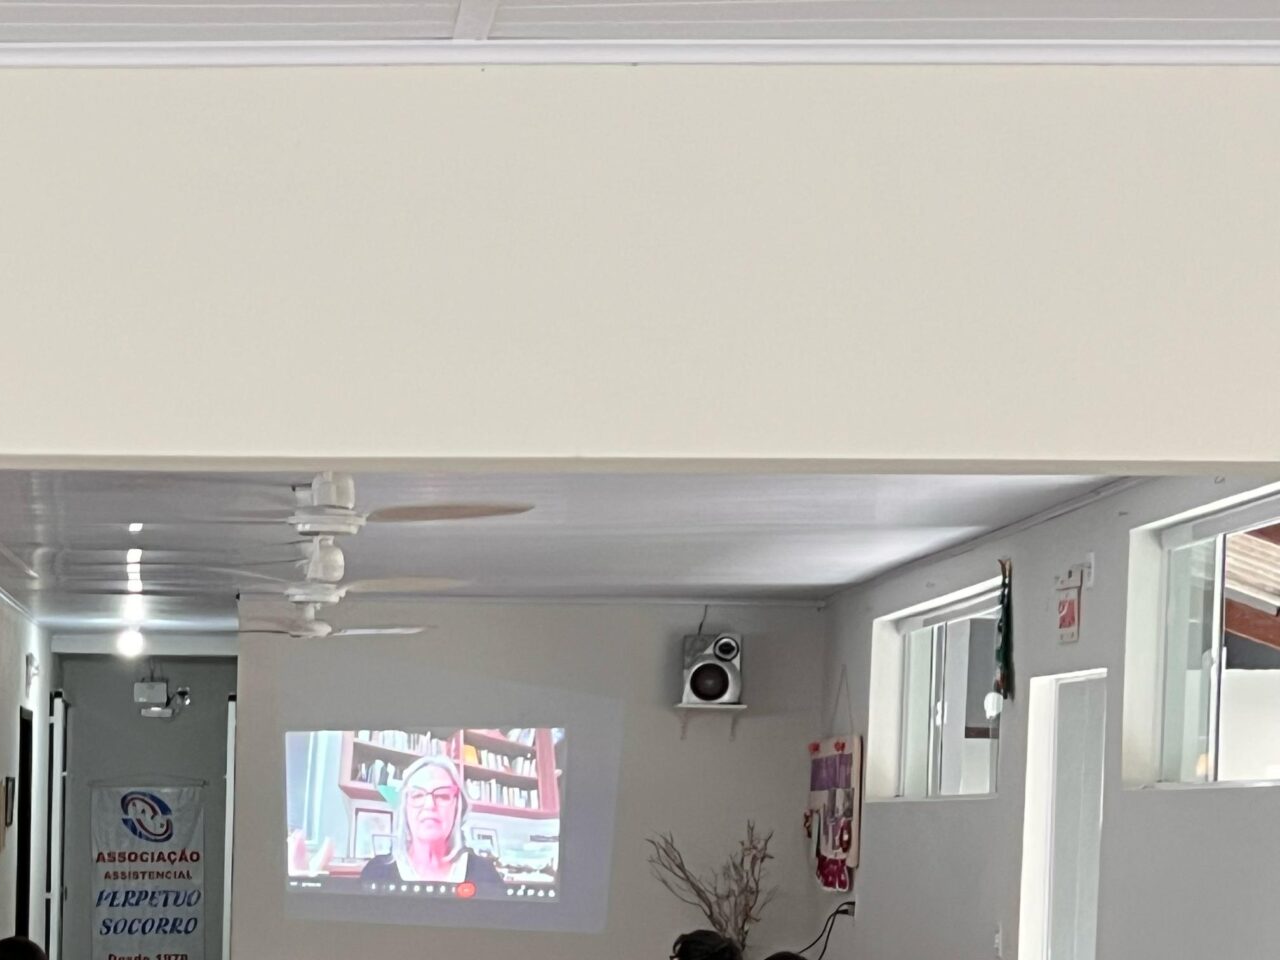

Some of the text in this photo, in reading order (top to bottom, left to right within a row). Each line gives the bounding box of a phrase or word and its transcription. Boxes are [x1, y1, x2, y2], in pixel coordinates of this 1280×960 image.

[96, 848, 200, 865] ASSOCIAÇÃO
[104, 870, 192, 880] ASSISTENCIAL
[99, 917, 198, 935] SOCORRO
